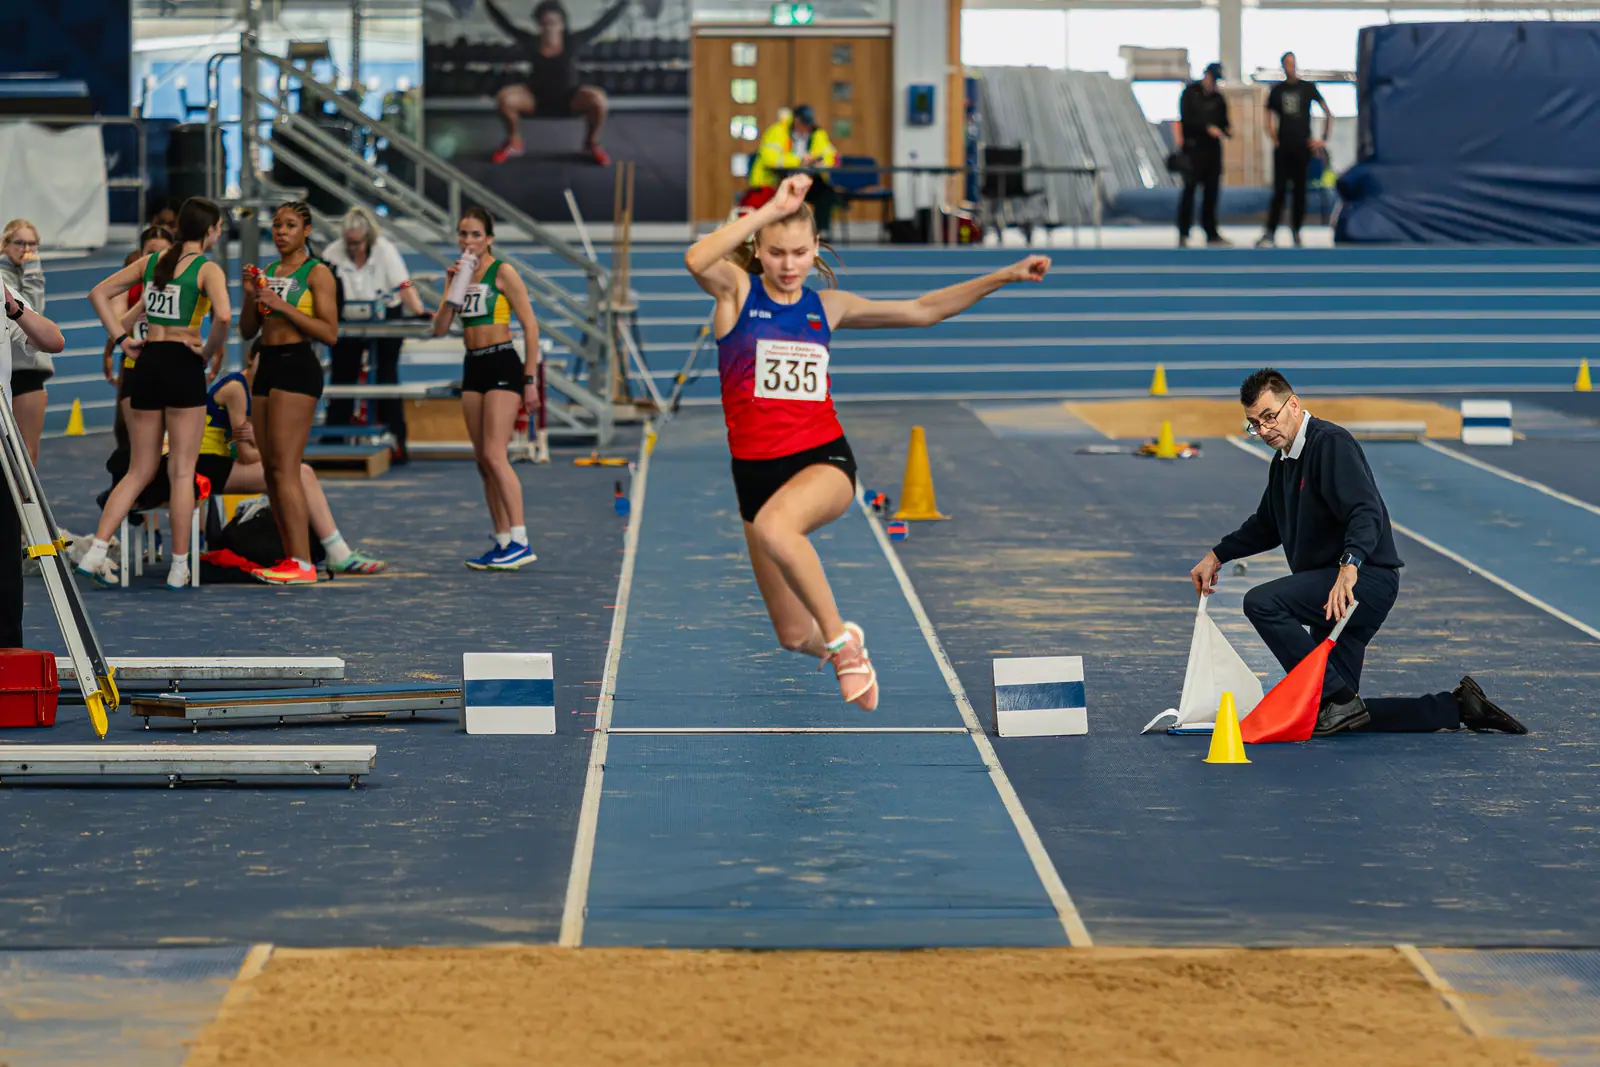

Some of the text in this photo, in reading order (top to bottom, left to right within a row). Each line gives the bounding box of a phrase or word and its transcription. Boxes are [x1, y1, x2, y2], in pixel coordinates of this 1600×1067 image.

[148, 292, 174, 315] 221
[464, 294, 480, 312] 27
[764, 359, 817, 393] 335
